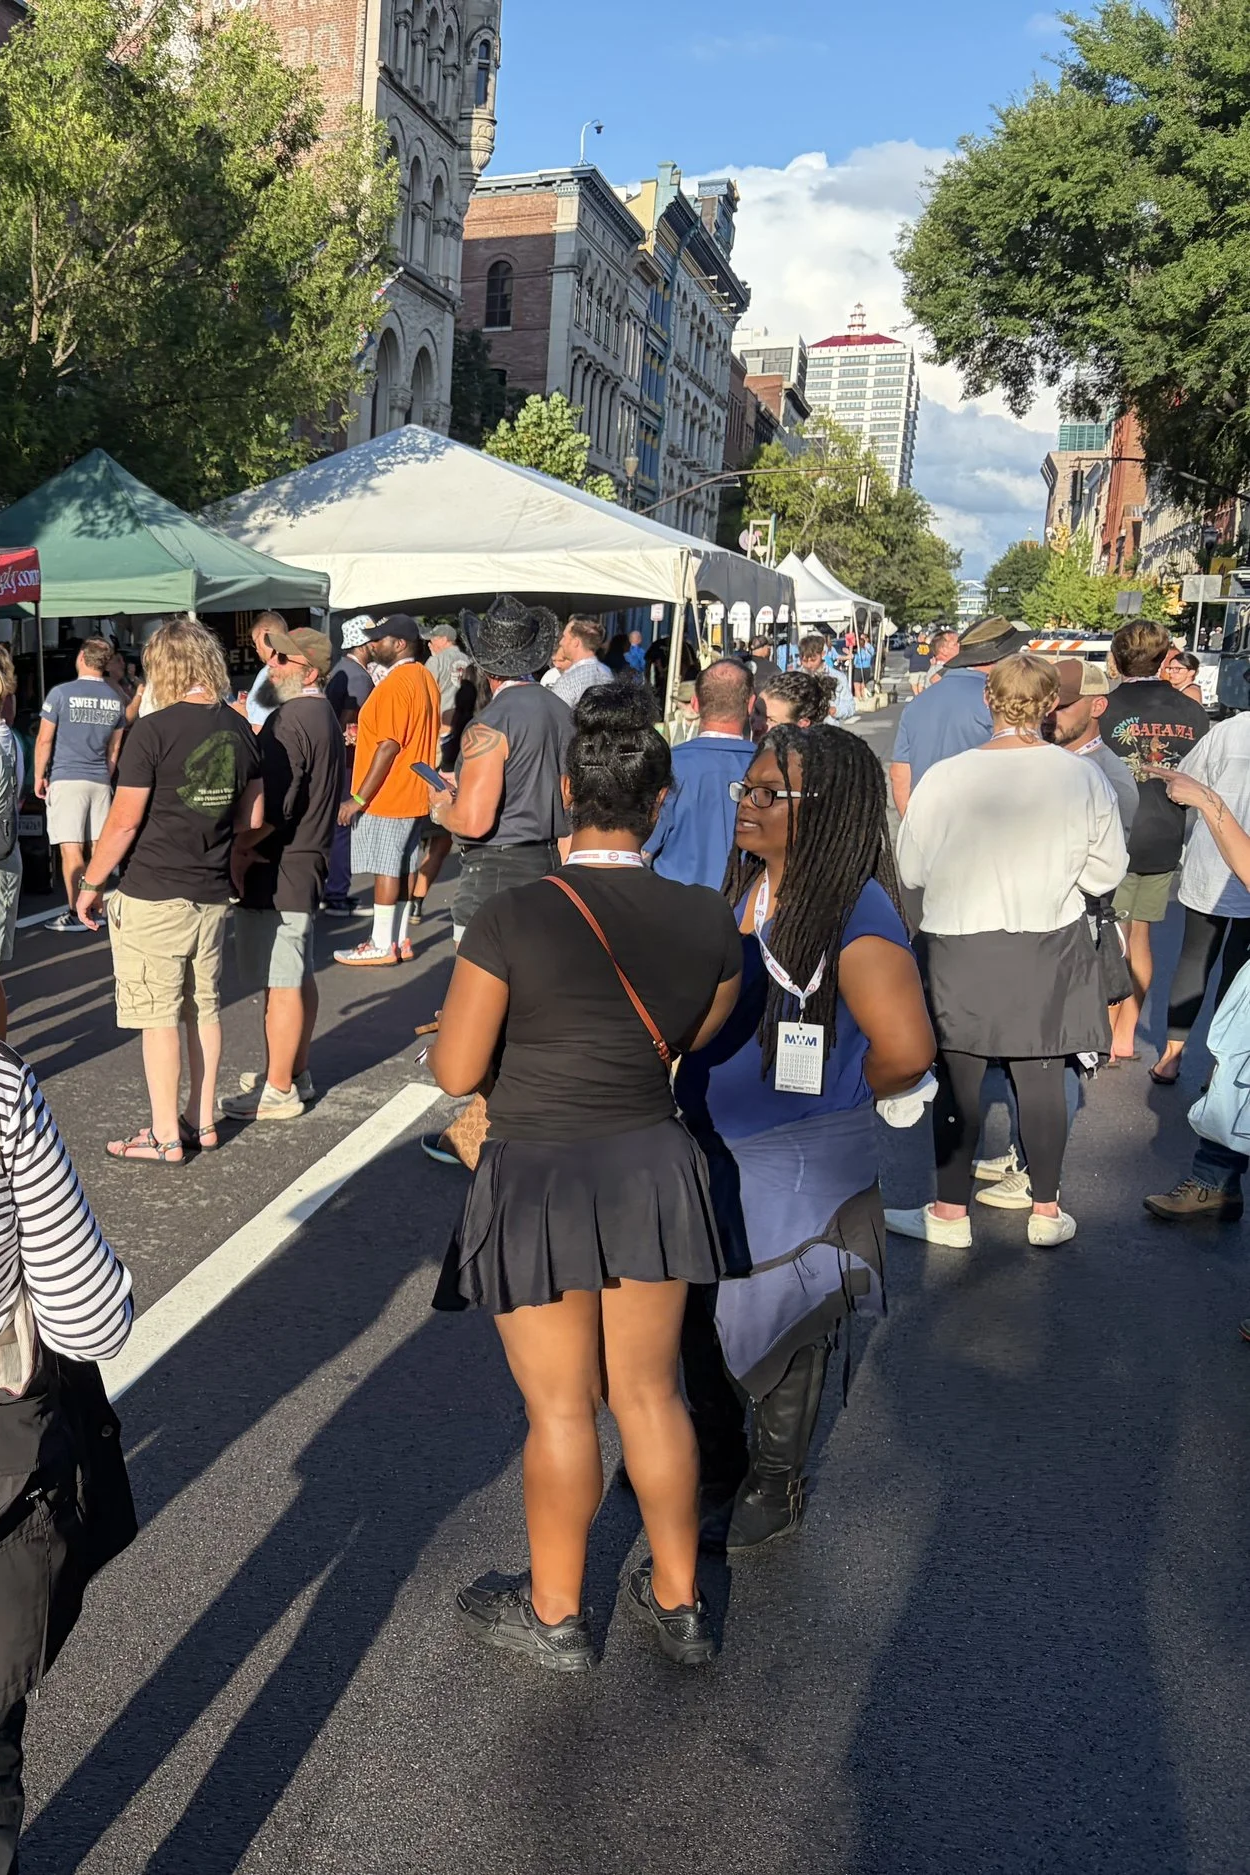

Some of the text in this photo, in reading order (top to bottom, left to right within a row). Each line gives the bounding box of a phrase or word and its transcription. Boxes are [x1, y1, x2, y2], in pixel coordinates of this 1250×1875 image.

[69, 697, 121, 712] SWEET MASH
[1111, 716, 1140, 738] TOMMY
